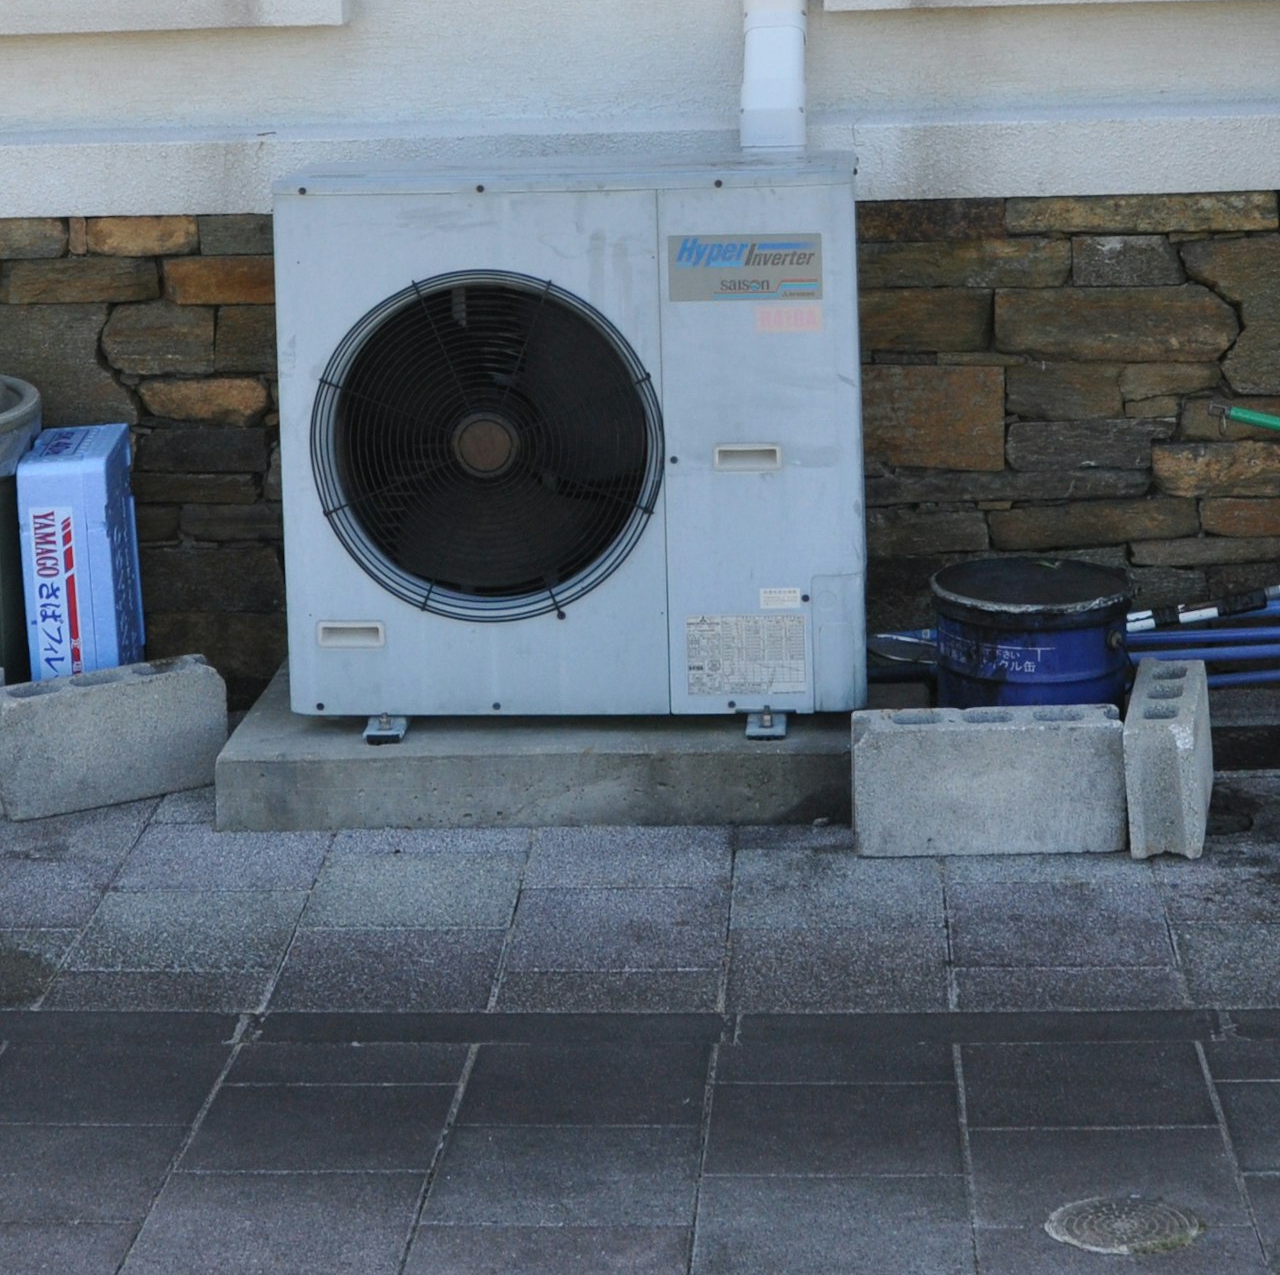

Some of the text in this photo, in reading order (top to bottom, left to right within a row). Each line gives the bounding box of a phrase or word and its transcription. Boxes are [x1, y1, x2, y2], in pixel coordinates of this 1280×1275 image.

[677, 237, 816, 268] Hyper Inverter
[720, 279, 771, 292] saison
[32, 510, 60, 579] YAMAGO
[38, 581, 66, 678] さばフィレ
